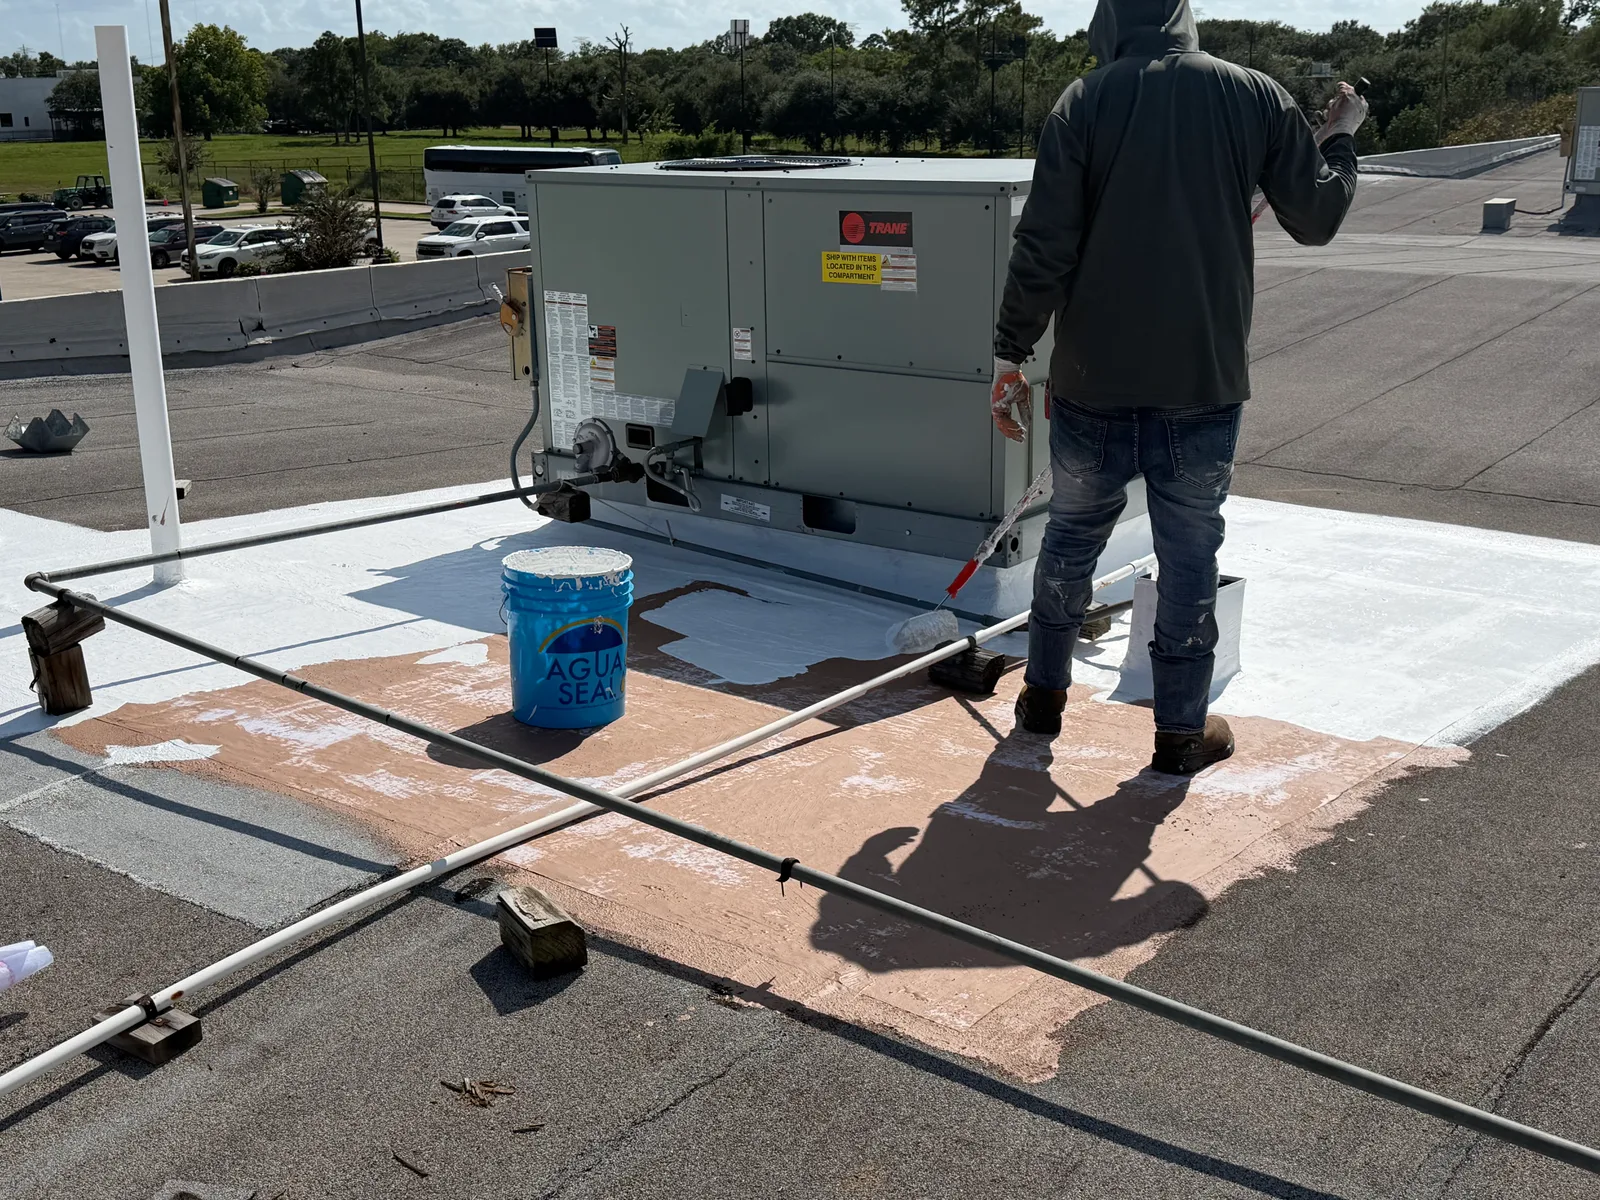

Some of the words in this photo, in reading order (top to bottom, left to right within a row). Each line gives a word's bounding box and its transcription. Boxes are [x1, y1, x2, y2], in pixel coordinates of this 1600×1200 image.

[869, 222, 908, 234] TRANE
[841, 254, 856, 262] WITH
[857, 255, 877, 263] ITEMS
[826, 263, 855, 271] LOCATED
[864, 264, 877, 272] THIS
[828, 272, 875, 280] COMPARTMENT
[546, 651, 622, 681] AGUA
[558, 676, 616, 705] SEAL
